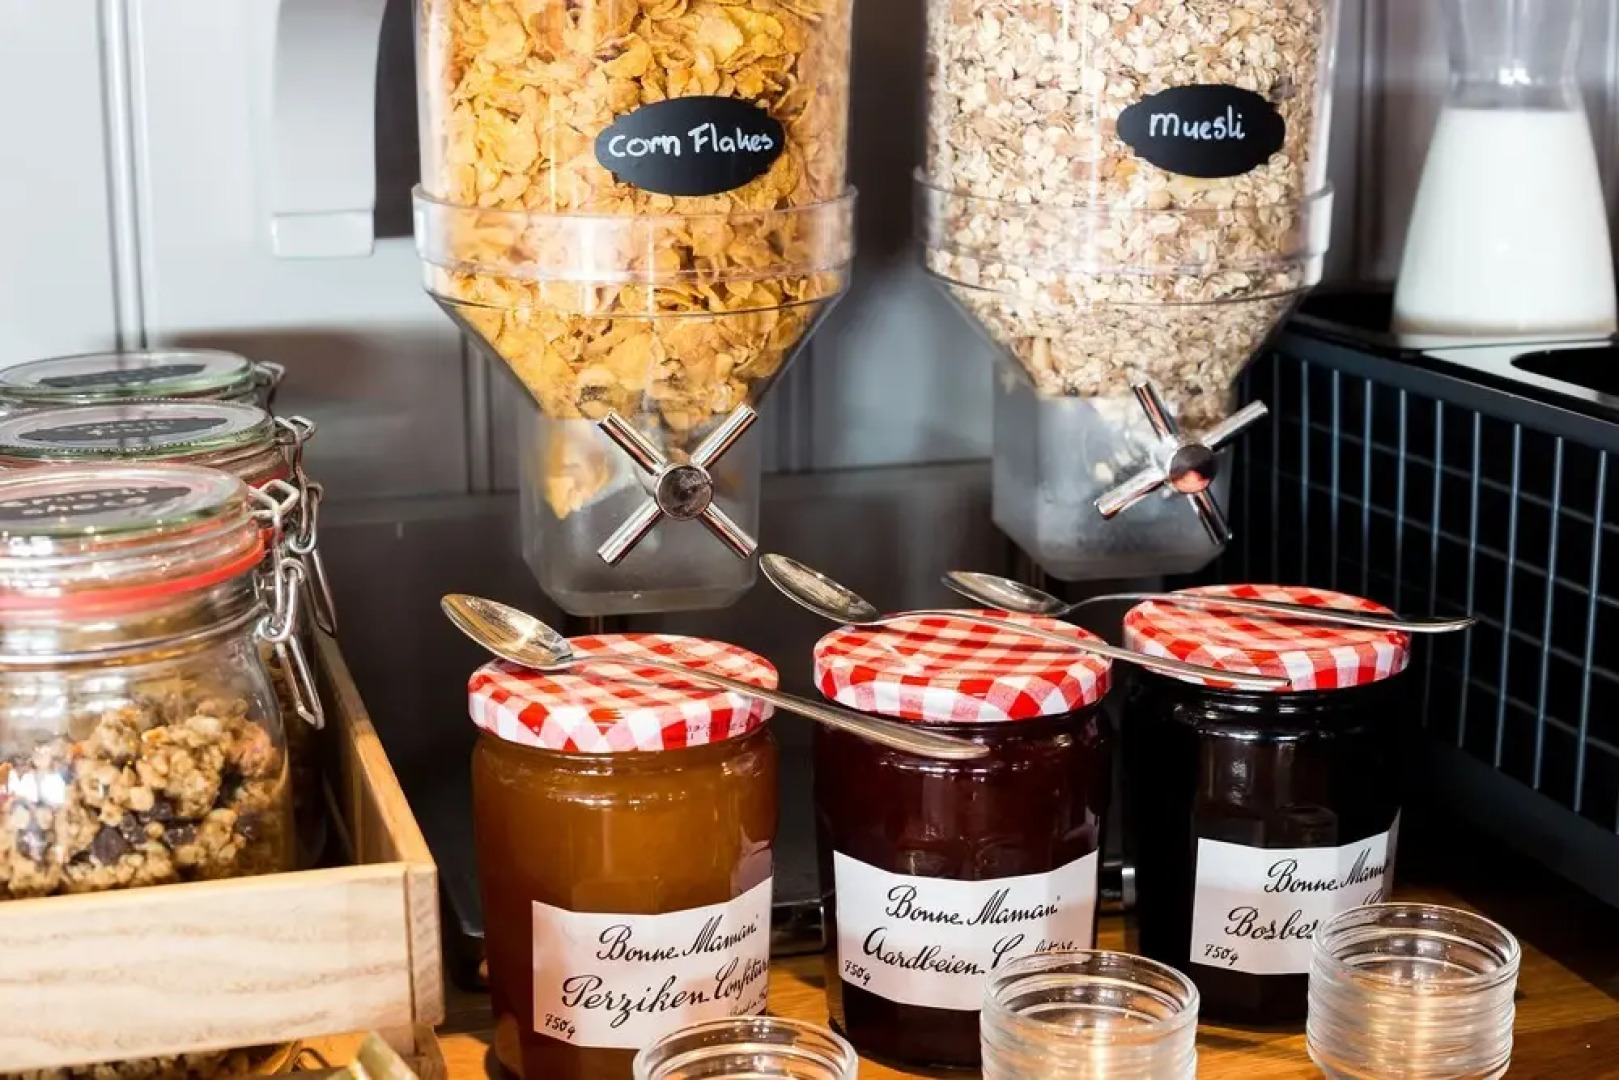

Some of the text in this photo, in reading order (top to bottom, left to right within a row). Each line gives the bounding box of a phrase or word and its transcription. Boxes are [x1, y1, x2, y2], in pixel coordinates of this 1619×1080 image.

[687, 122, 774, 153] Flakes
[1263, 847, 1389, 893] Bonne Mam
[884, 883, 1058, 926] Bonne Maman
[1223, 906, 1319, 940] Bosbes
[595, 913, 758, 962] Bonne Maman
[862, 926, 986, 975] Aardbeien
[561, 974, 710, 1029] Perziken
[713, 956, 768, 1001] Confitur
